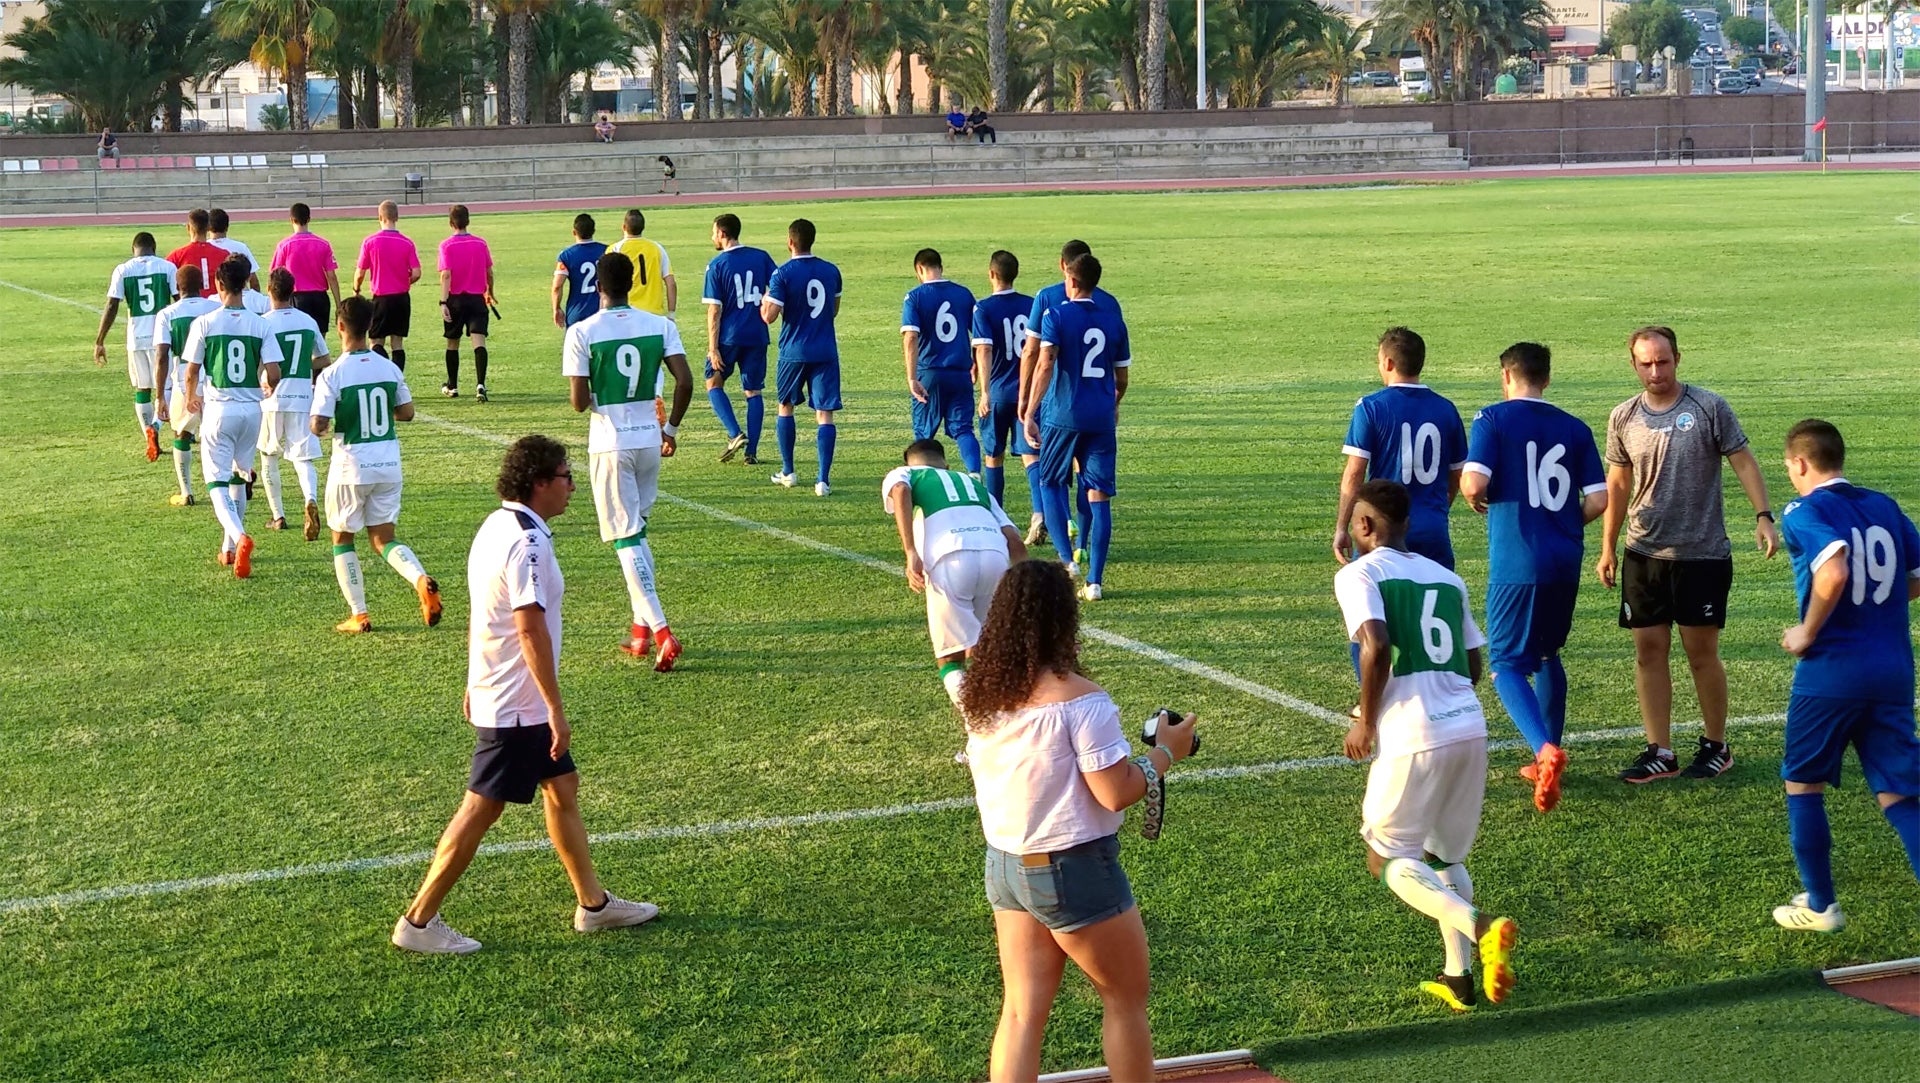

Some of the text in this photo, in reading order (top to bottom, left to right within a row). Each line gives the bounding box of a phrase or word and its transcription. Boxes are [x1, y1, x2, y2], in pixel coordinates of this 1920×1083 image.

[1837, 21, 1884, 35] ALDI
[201, 257, 210, 290] 1
[638, 253, 647, 286] 1
[733, 270, 762, 310] 14
[137, 277, 155, 313] 5
[806, 278, 826, 319] 9
[935, 301, 958, 343] 6
[1003, 314, 1029, 361] 18
[227, 339, 246, 383] 8
[285, 333, 303, 375] 7
[616, 343, 641, 398] 9
[1082, 327, 1106, 378] 2
[357, 386, 390, 439] 10
[1401, 422, 1441, 485] 10
[935, 469, 980, 502] 11
[1526, 440, 1571, 512] 16
[1851, 525, 1897, 606] 19
[1420, 589, 1453, 665] 6
